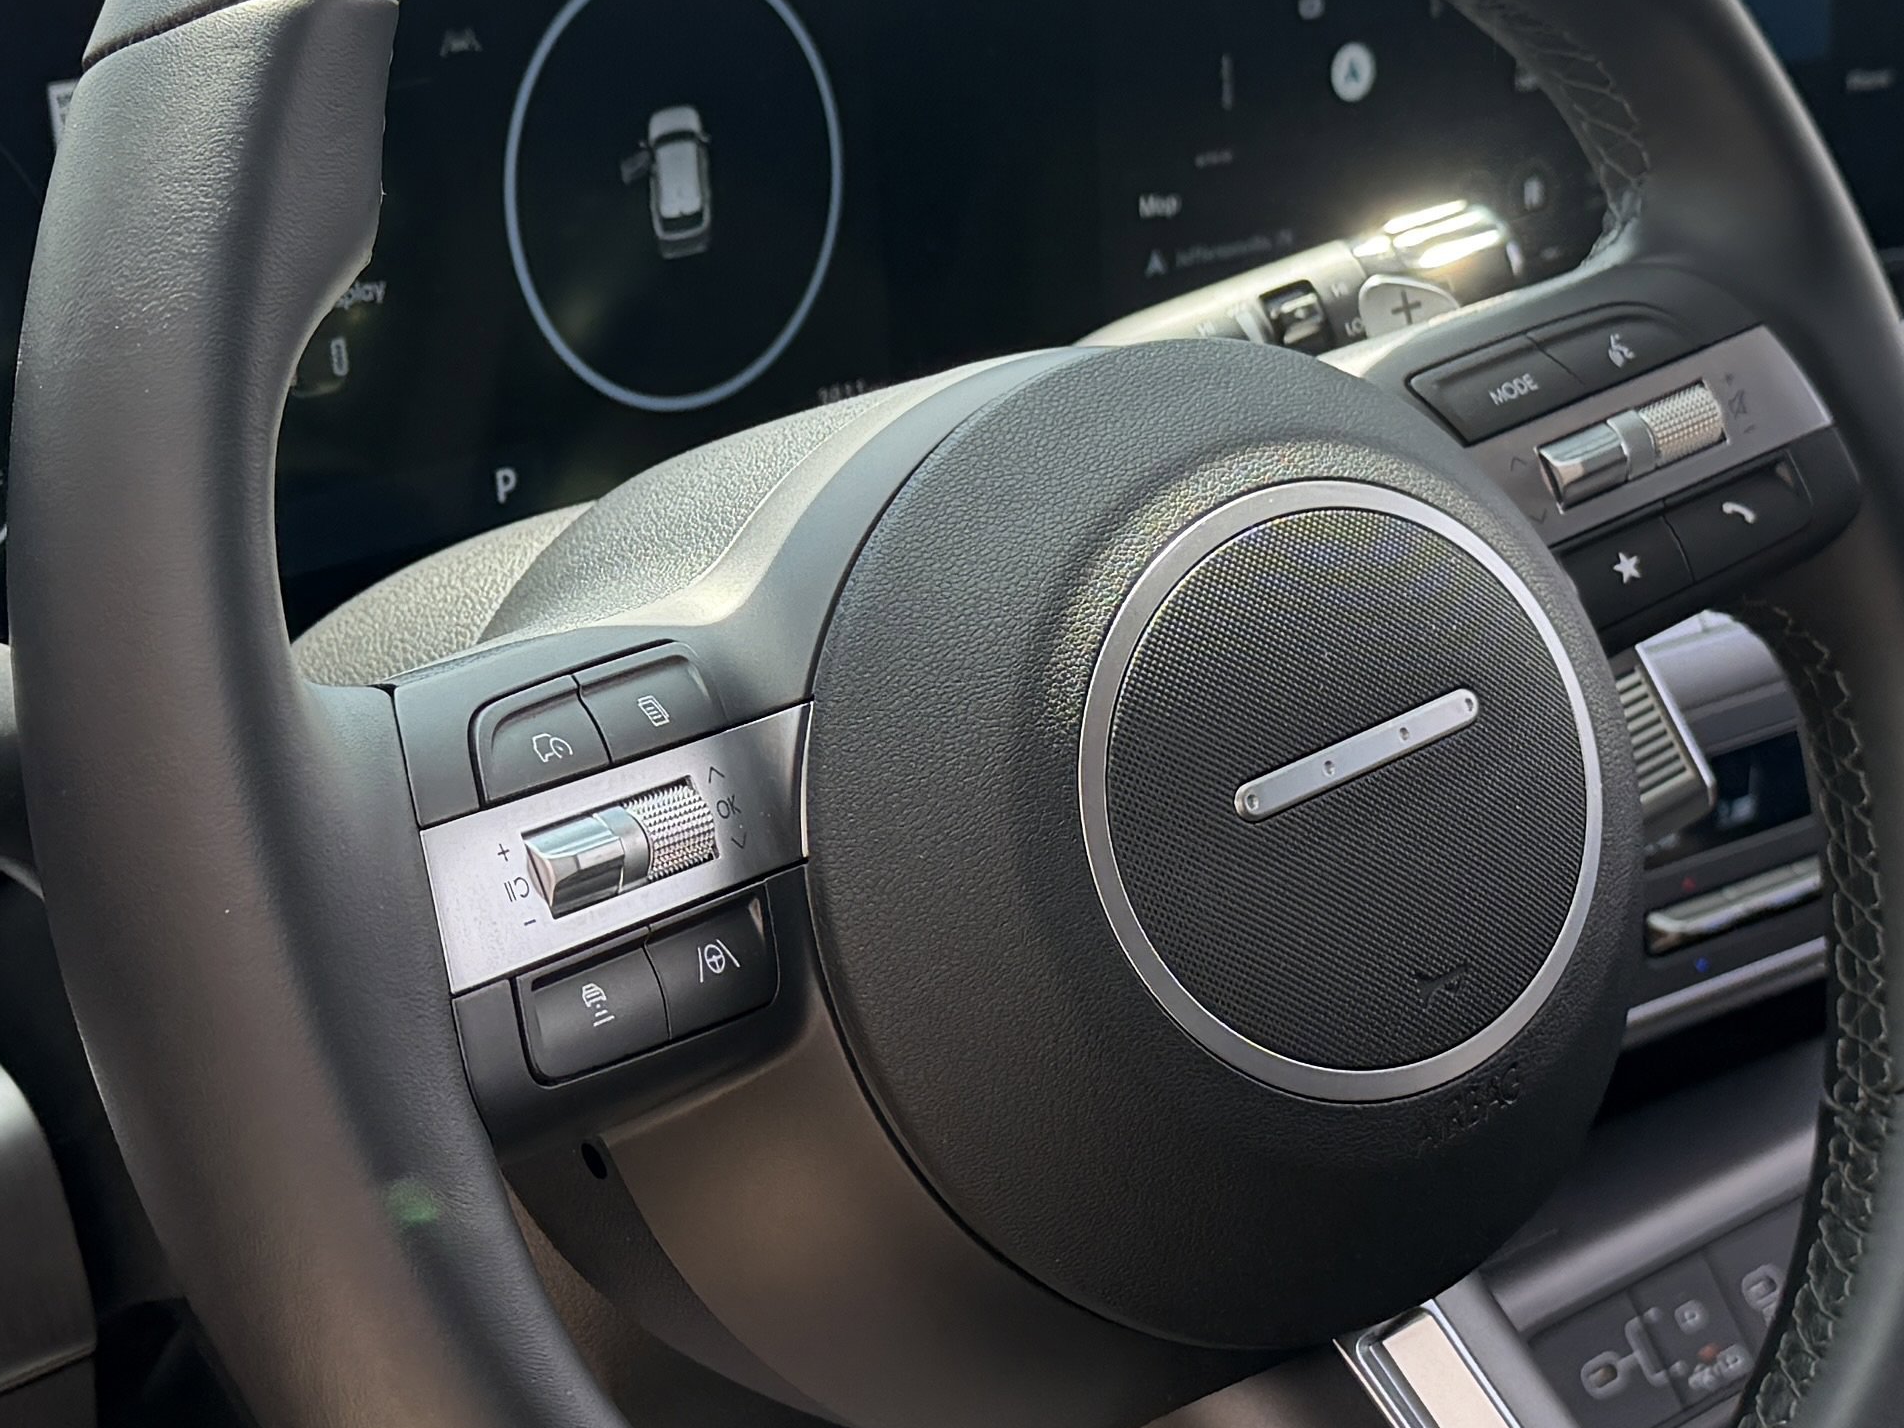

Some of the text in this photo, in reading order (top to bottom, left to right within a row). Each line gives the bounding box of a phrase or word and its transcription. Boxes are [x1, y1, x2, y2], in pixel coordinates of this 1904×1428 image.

[1489, 373, 1539, 406] MODE
[496, 467, 517, 504] P
[715, 795, 743, 820] OK
[1416, 1062, 1521, 1158] AIRBAG
